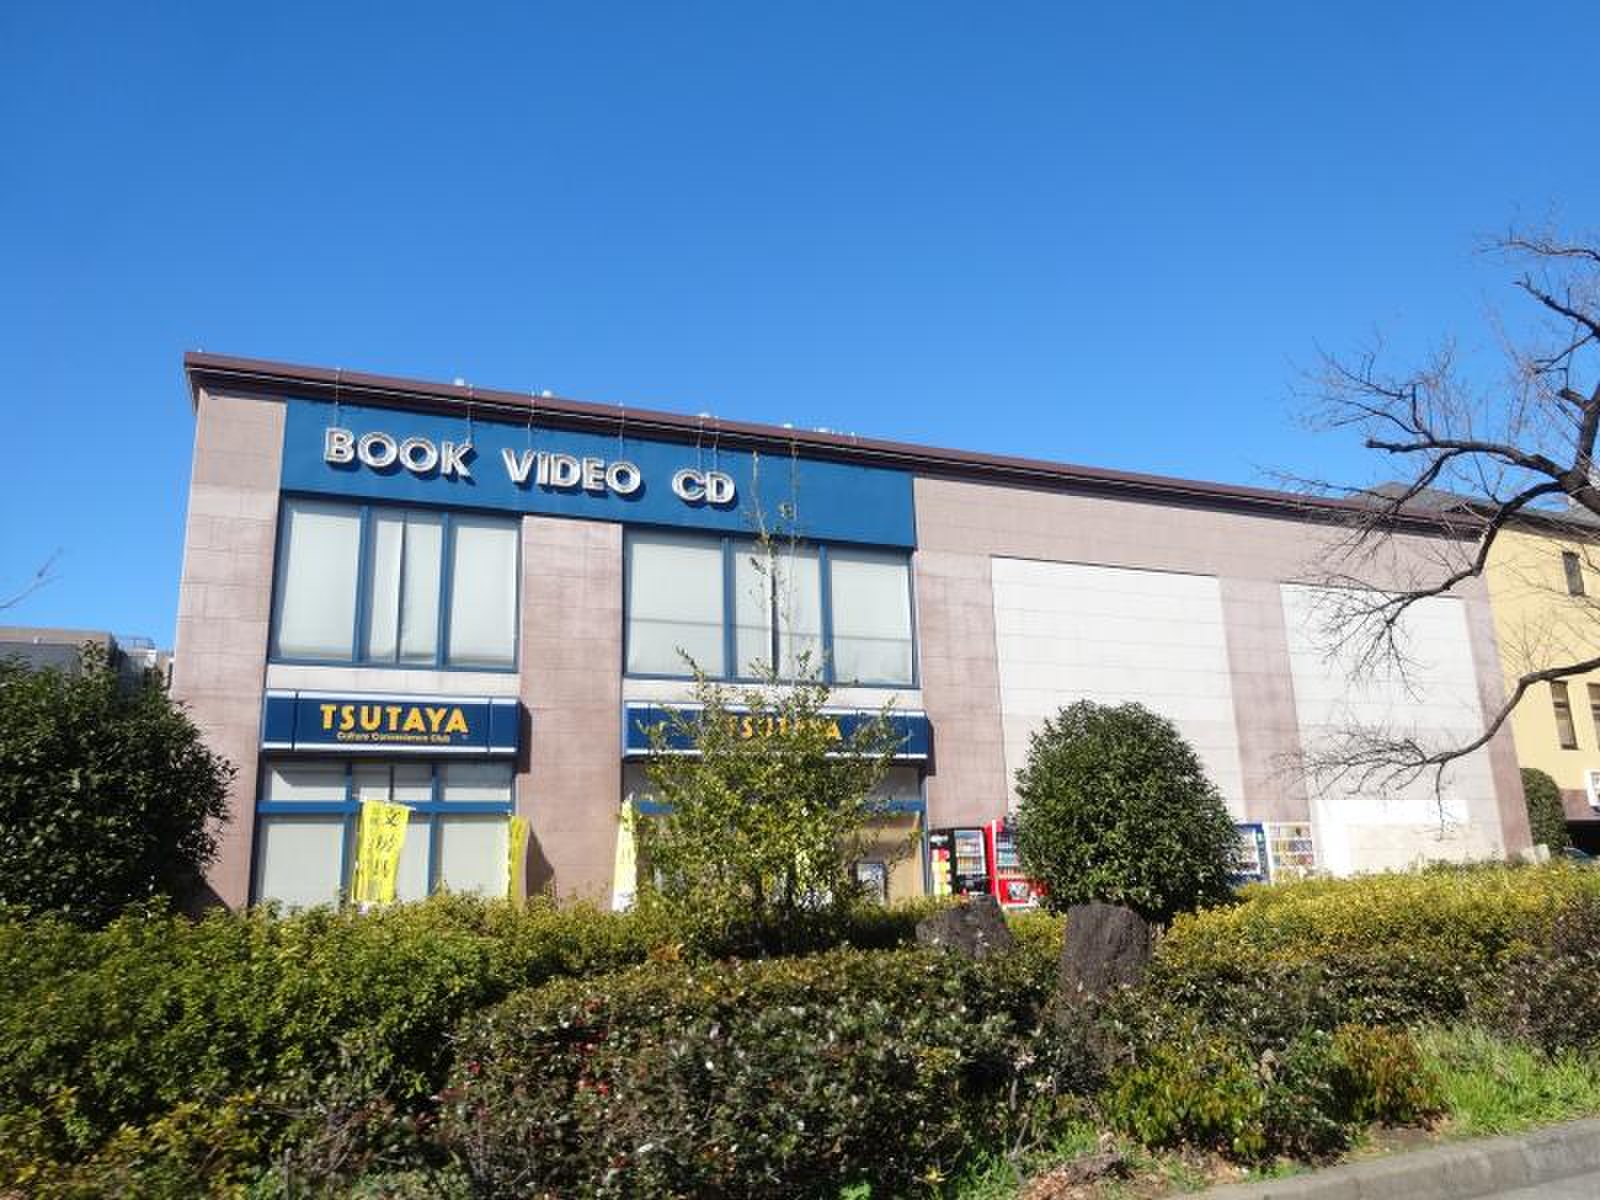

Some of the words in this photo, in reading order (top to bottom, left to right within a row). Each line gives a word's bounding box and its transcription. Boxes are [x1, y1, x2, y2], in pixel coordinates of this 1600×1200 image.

[324, 427, 473, 477] BOOK
[501, 448, 641, 494] VIDEO
[672, 468, 736, 503] CD
[320, 704, 469, 733] TSUTAYA
